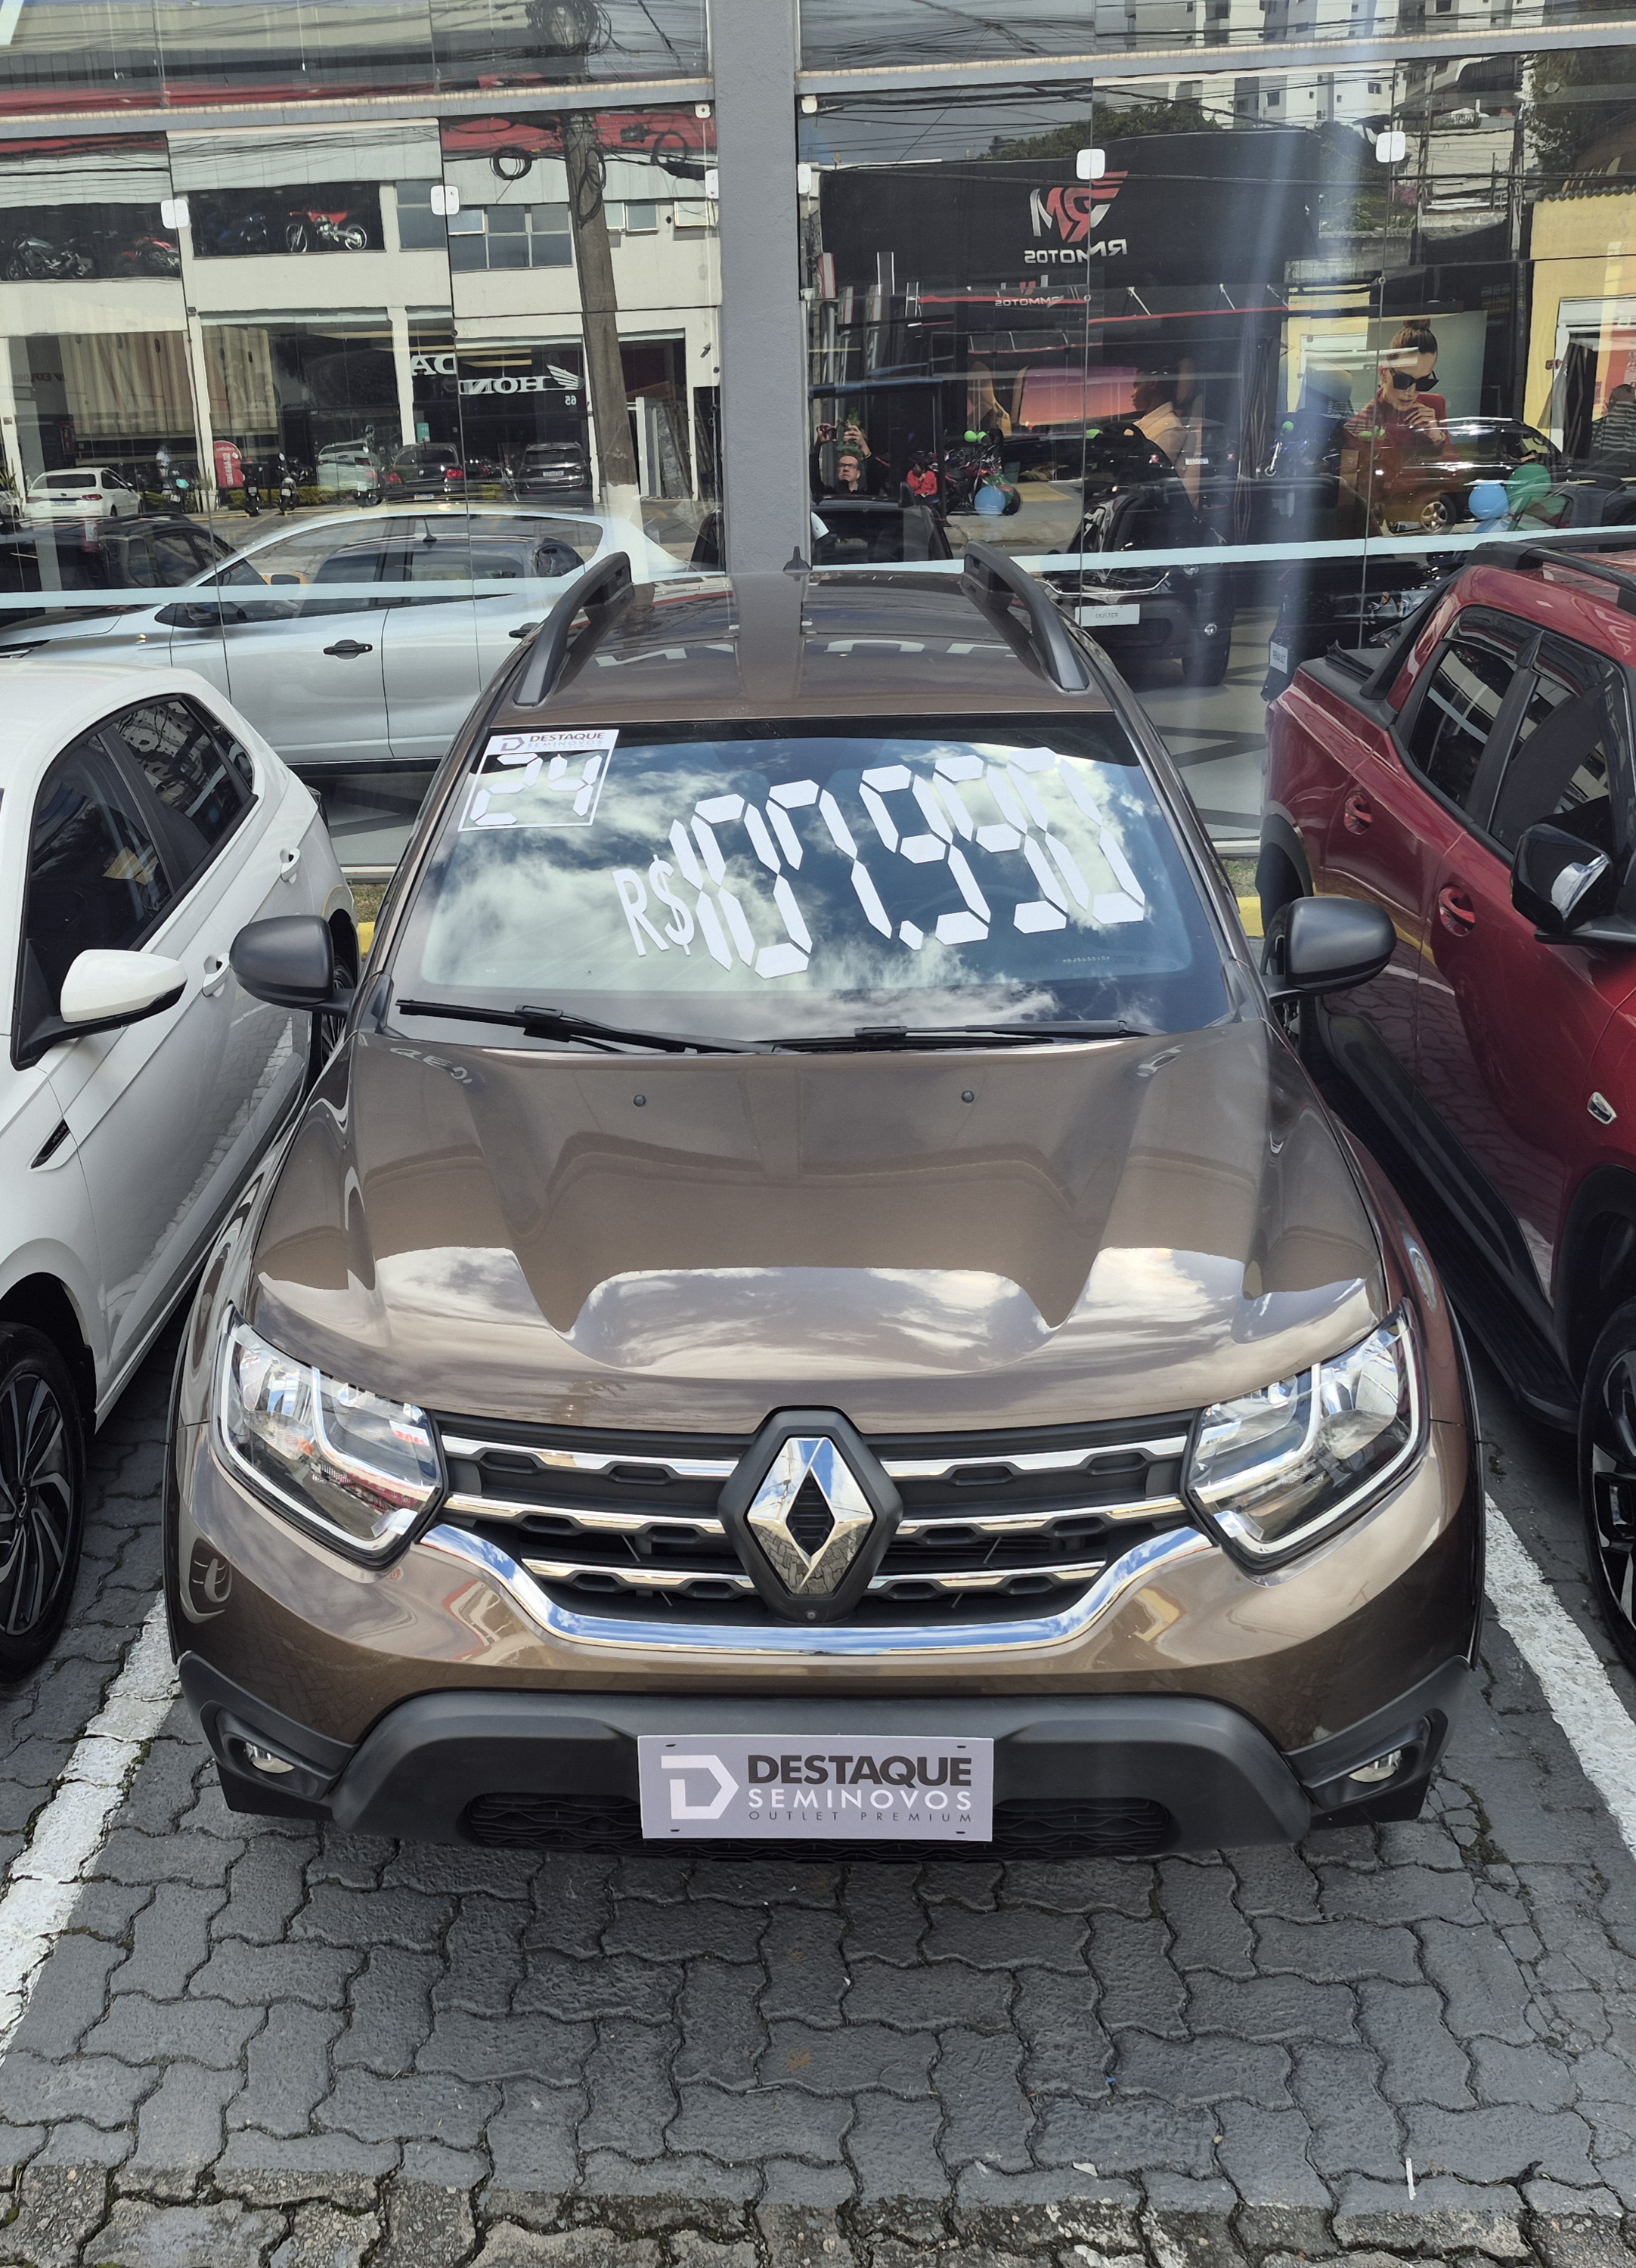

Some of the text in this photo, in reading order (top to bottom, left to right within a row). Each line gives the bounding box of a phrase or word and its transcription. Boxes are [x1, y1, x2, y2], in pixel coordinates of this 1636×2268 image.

[528, 732, 606, 742] DESTAQUE
[747, 1754, 972, 1789] DESTAQUE
[748, 1788, 972, 1811] SEMINOVOS
[748, 1811, 972, 1823] OUTLET PREMIUM
